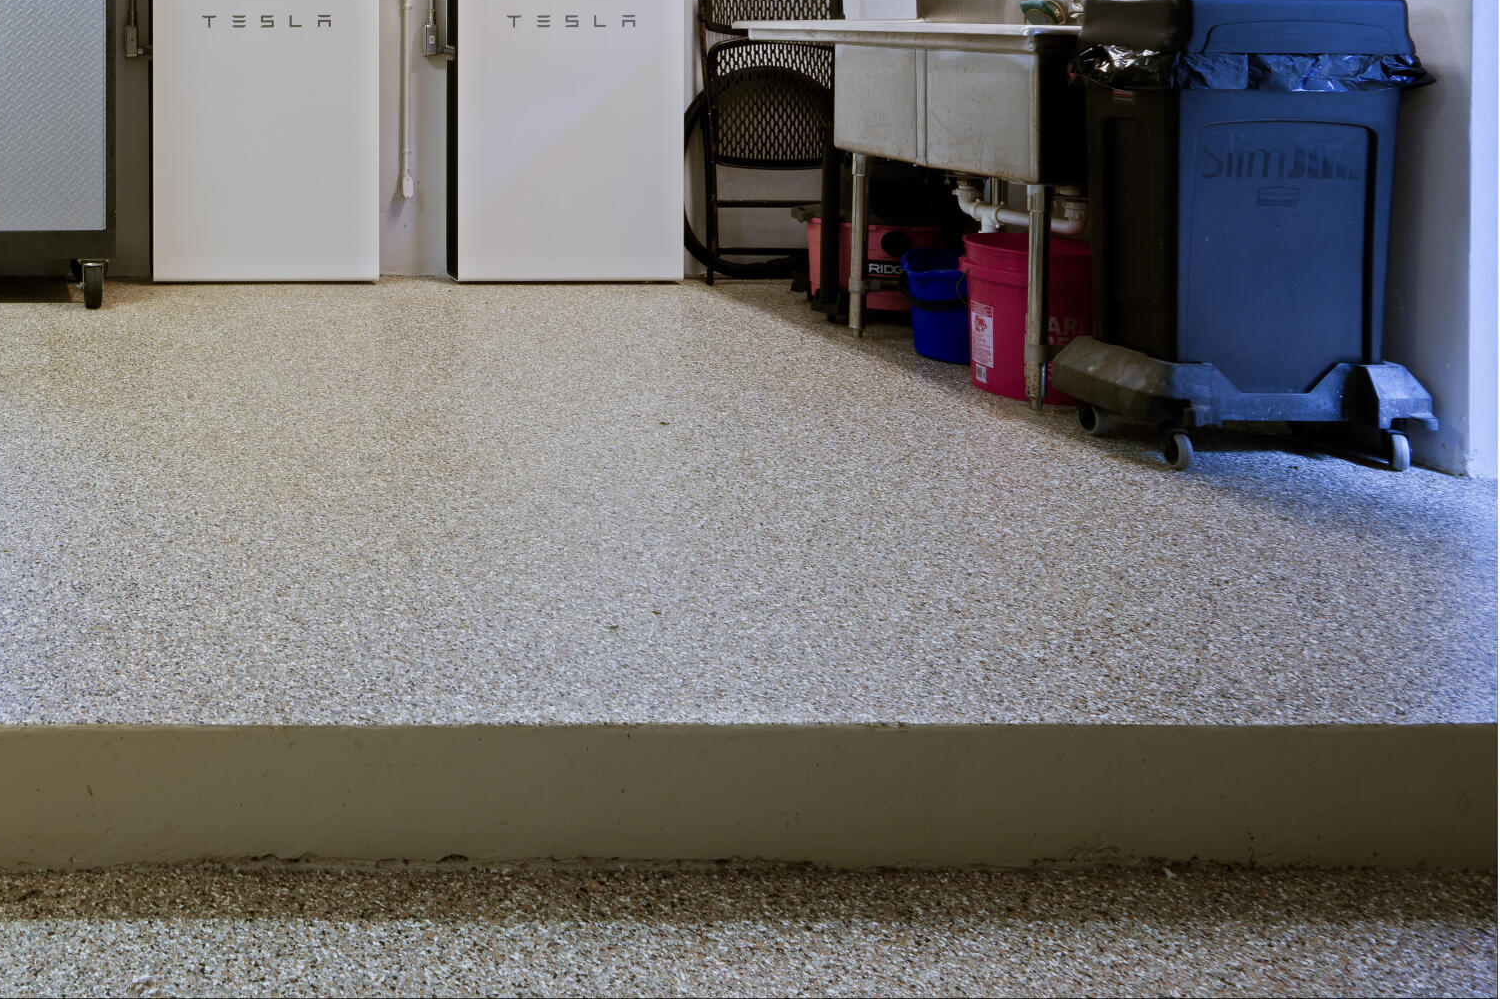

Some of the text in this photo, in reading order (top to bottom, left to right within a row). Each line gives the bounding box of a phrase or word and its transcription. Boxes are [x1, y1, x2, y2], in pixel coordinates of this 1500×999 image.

[201, 14, 332, 28] TESLA
[506, 14, 636, 28] TESLA
[868, 262, 904, 275] RIDG
